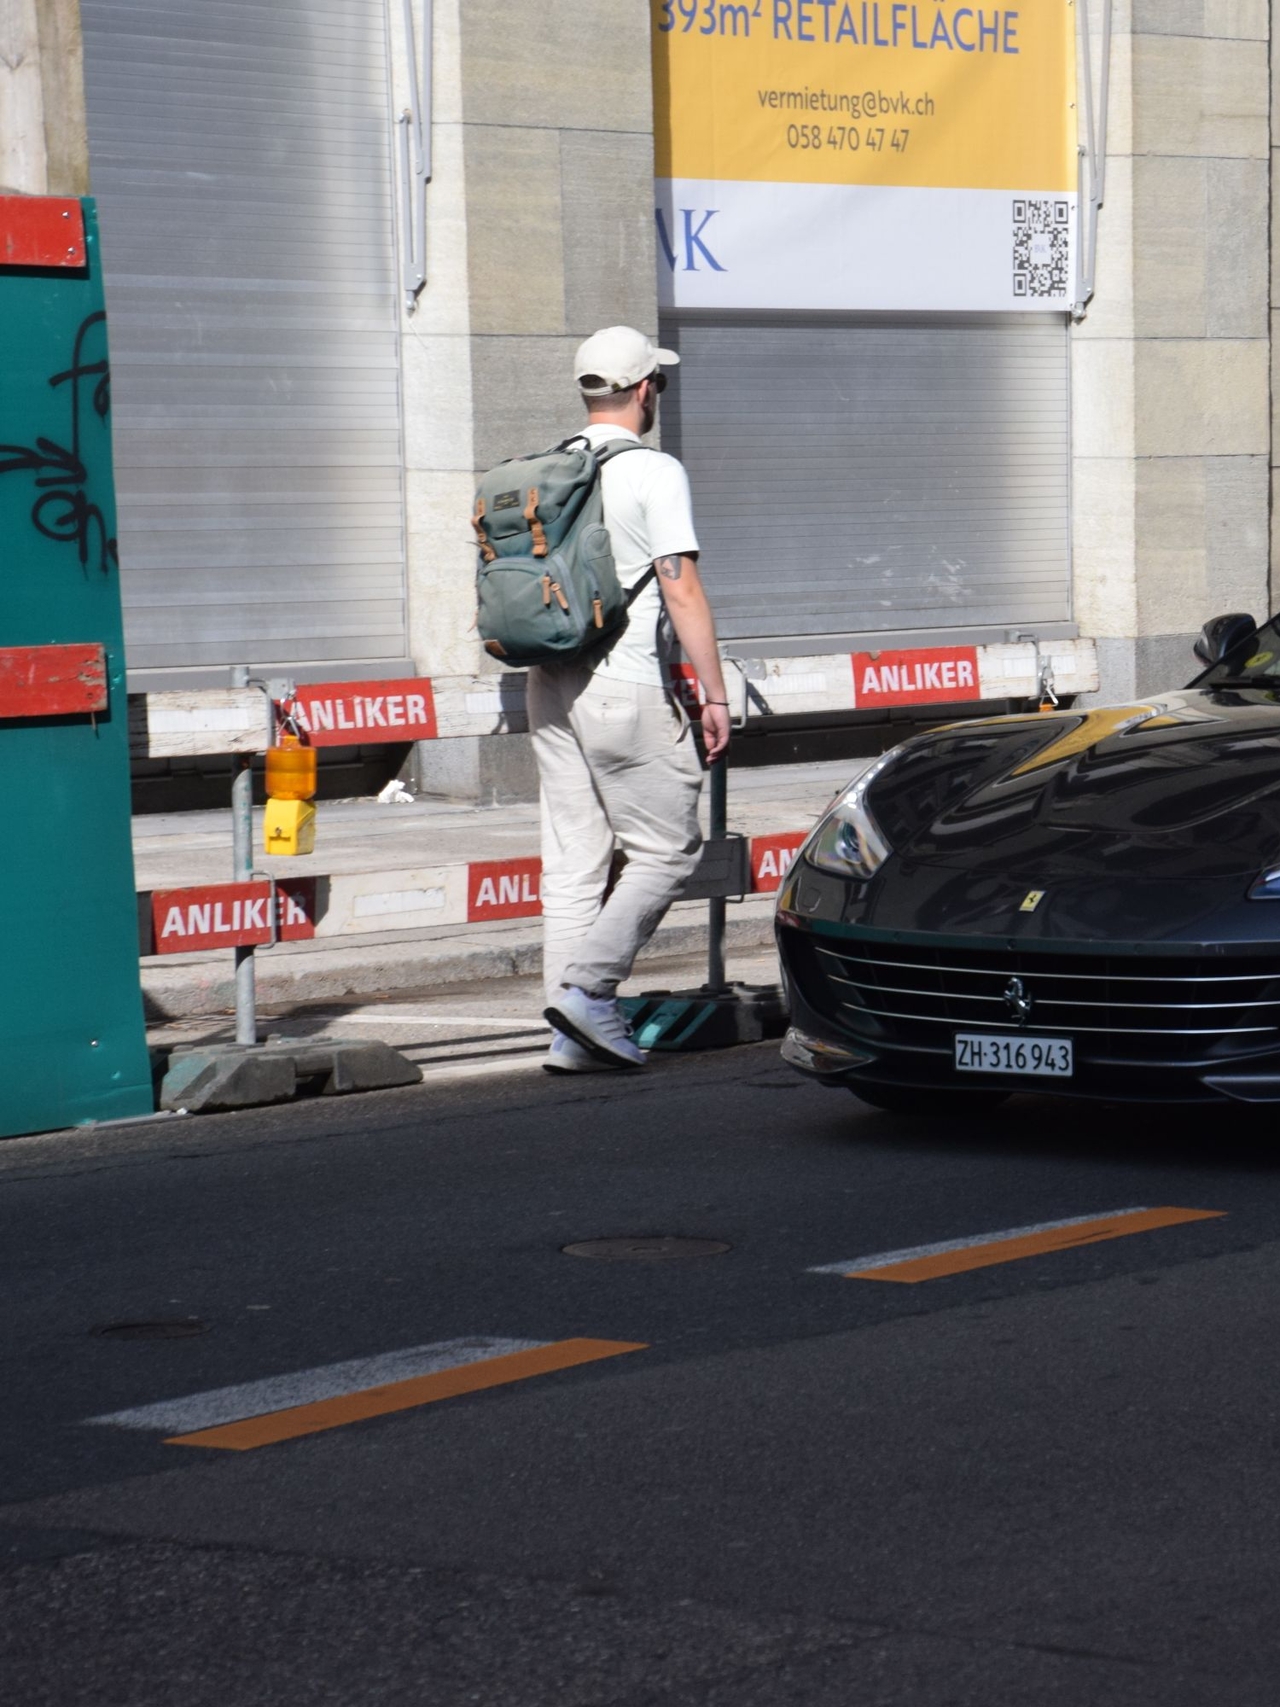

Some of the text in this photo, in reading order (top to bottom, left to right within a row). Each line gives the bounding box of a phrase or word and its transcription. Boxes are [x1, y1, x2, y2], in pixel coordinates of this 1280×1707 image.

[757, 86, 935, 119] vermietung@bvk.ch
[787, 124, 910, 153] 058 470 47 47
[861, 660, 975, 695] ANLIKER
[289, 694, 428, 732] ANLIKER
